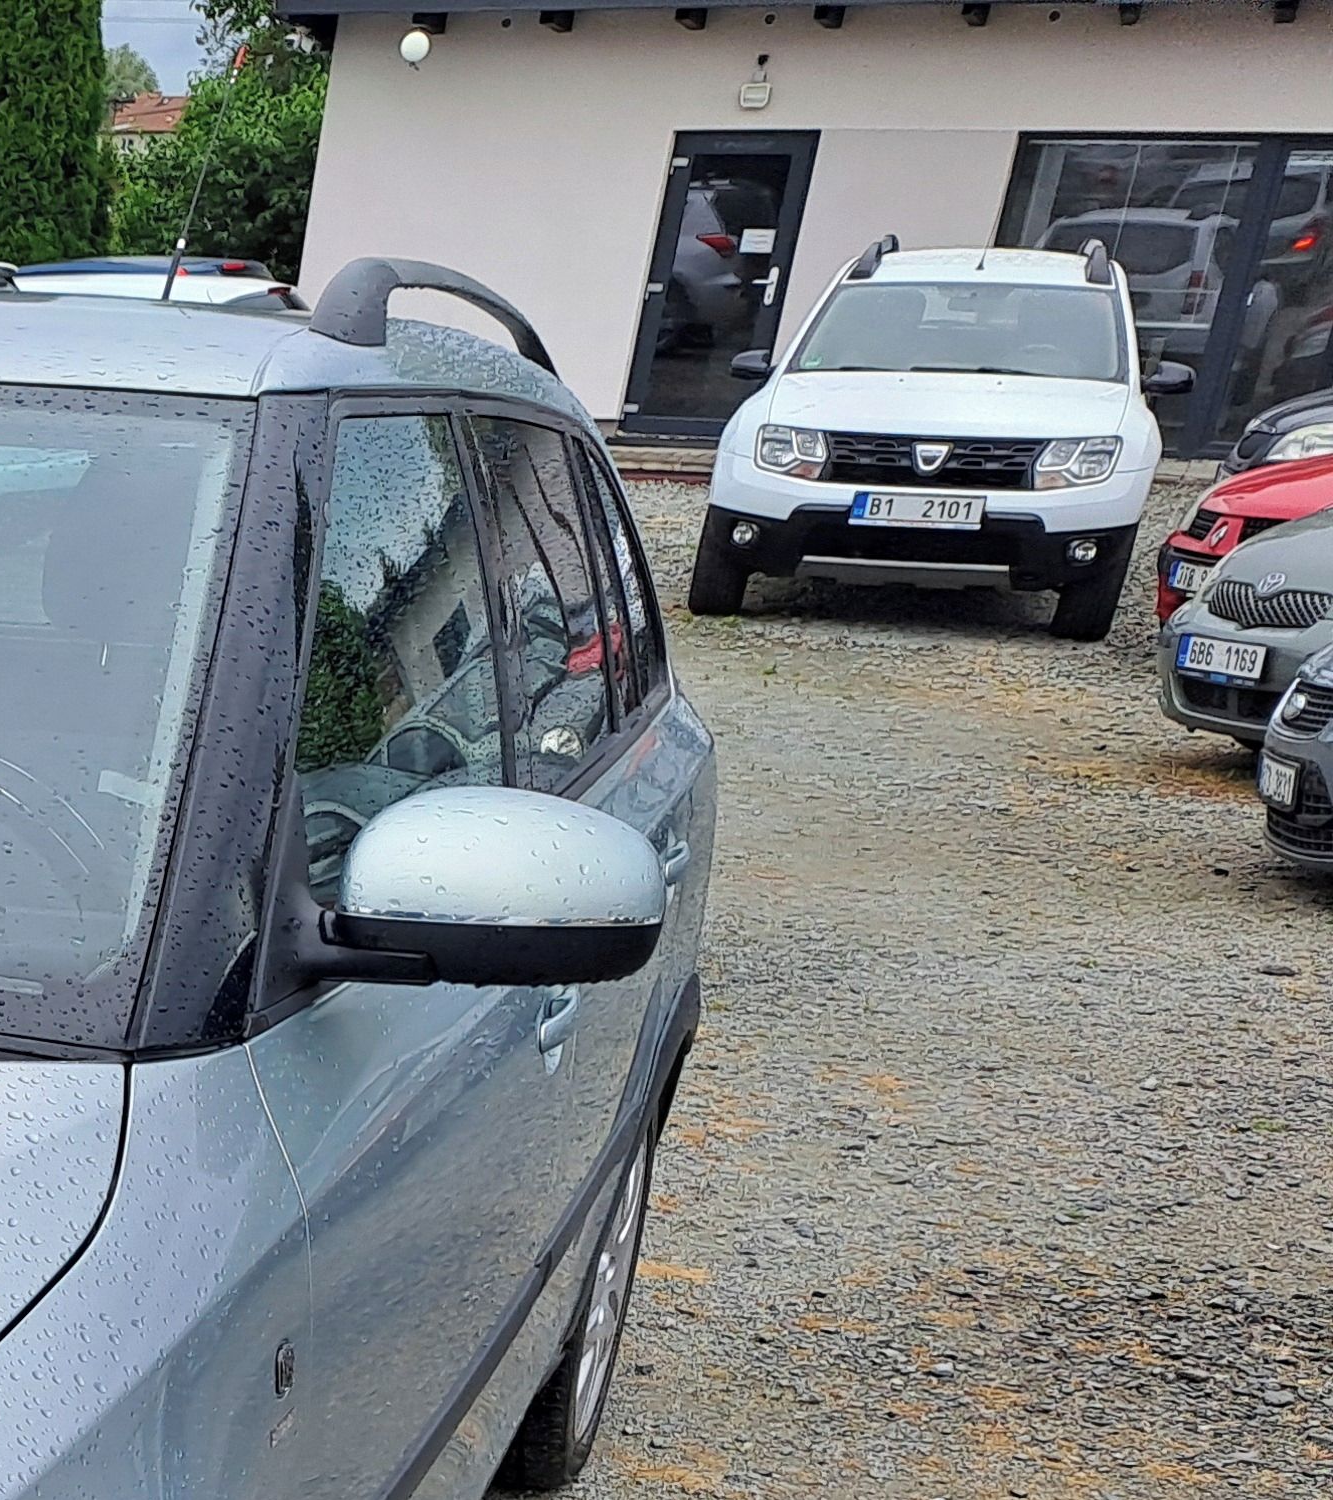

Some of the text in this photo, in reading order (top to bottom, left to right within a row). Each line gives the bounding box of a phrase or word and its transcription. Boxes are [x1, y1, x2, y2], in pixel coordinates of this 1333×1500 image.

[868, 498, 973, 521] B1 2101
[1189, 641, 1258, 673] 6B6 1169
